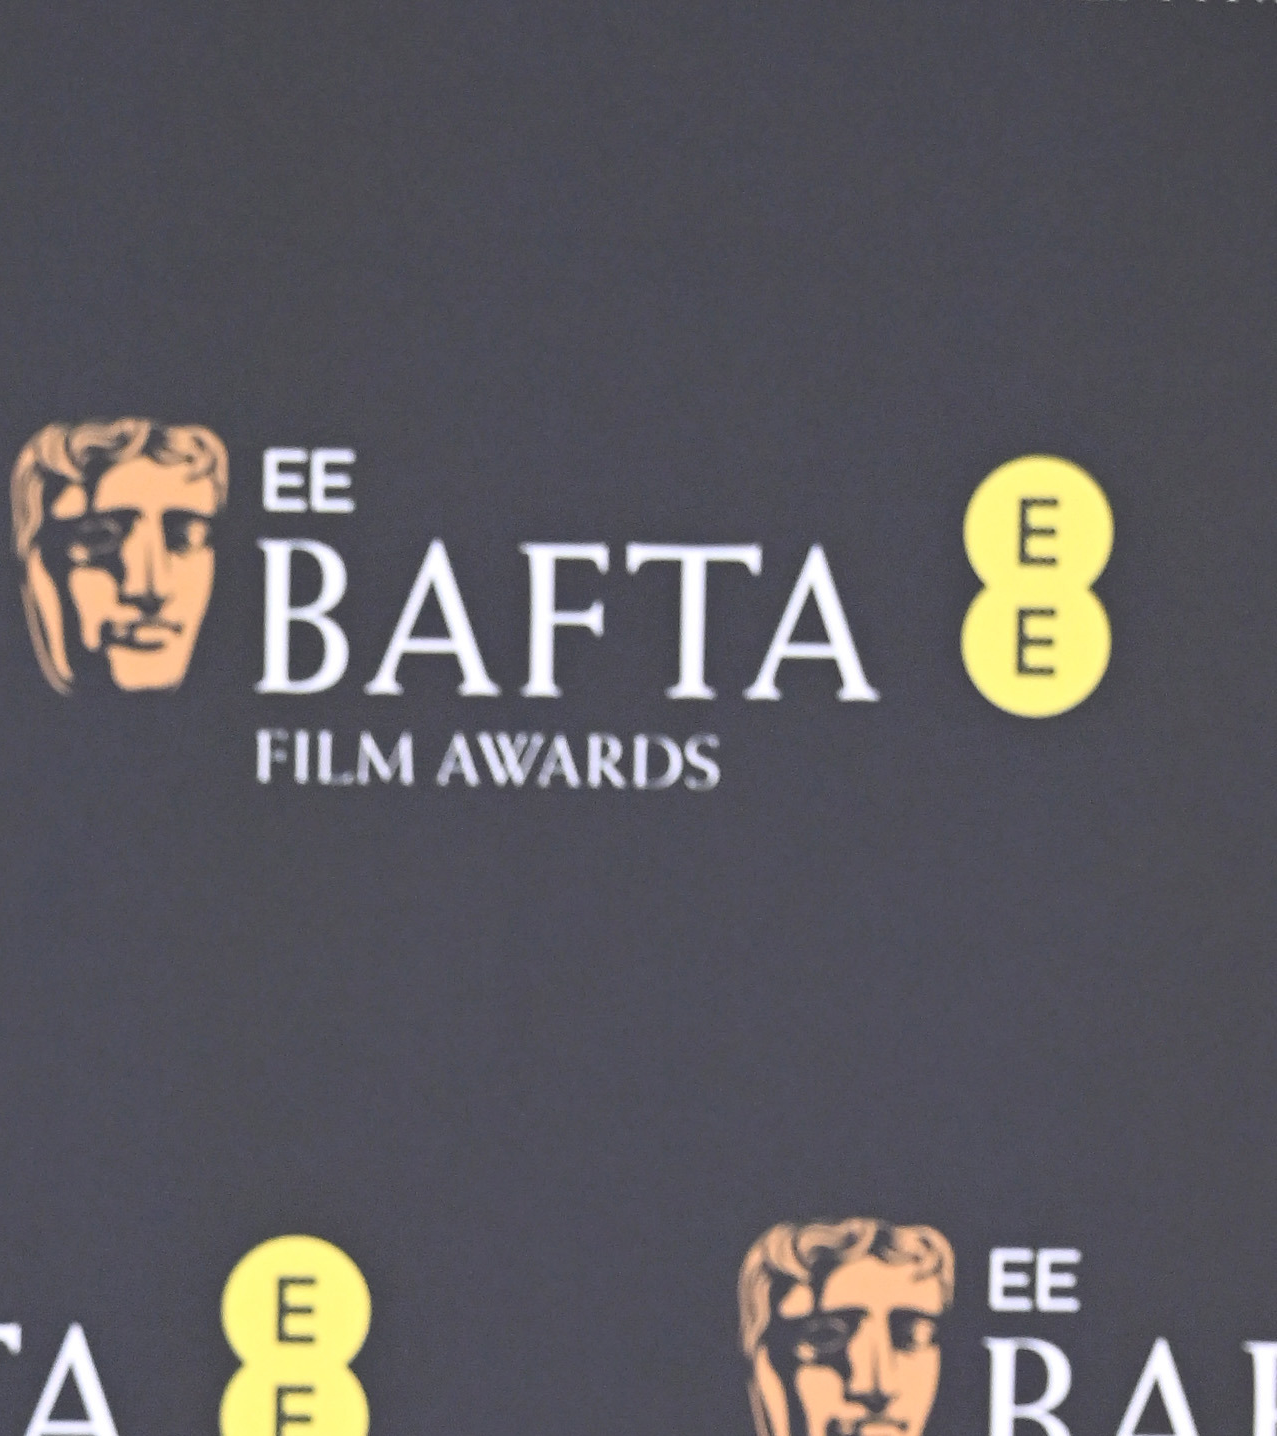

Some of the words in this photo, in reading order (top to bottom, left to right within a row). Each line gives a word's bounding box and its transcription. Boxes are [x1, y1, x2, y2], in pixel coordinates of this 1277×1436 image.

[262, 447, 356, 513] EE
[255, 538, 880, 702] BAFTA
[256, 729, 414, 786] FILM
[437, 732, 721, 790] AWARDS
[988, 1247, 1082, 1313] EE
